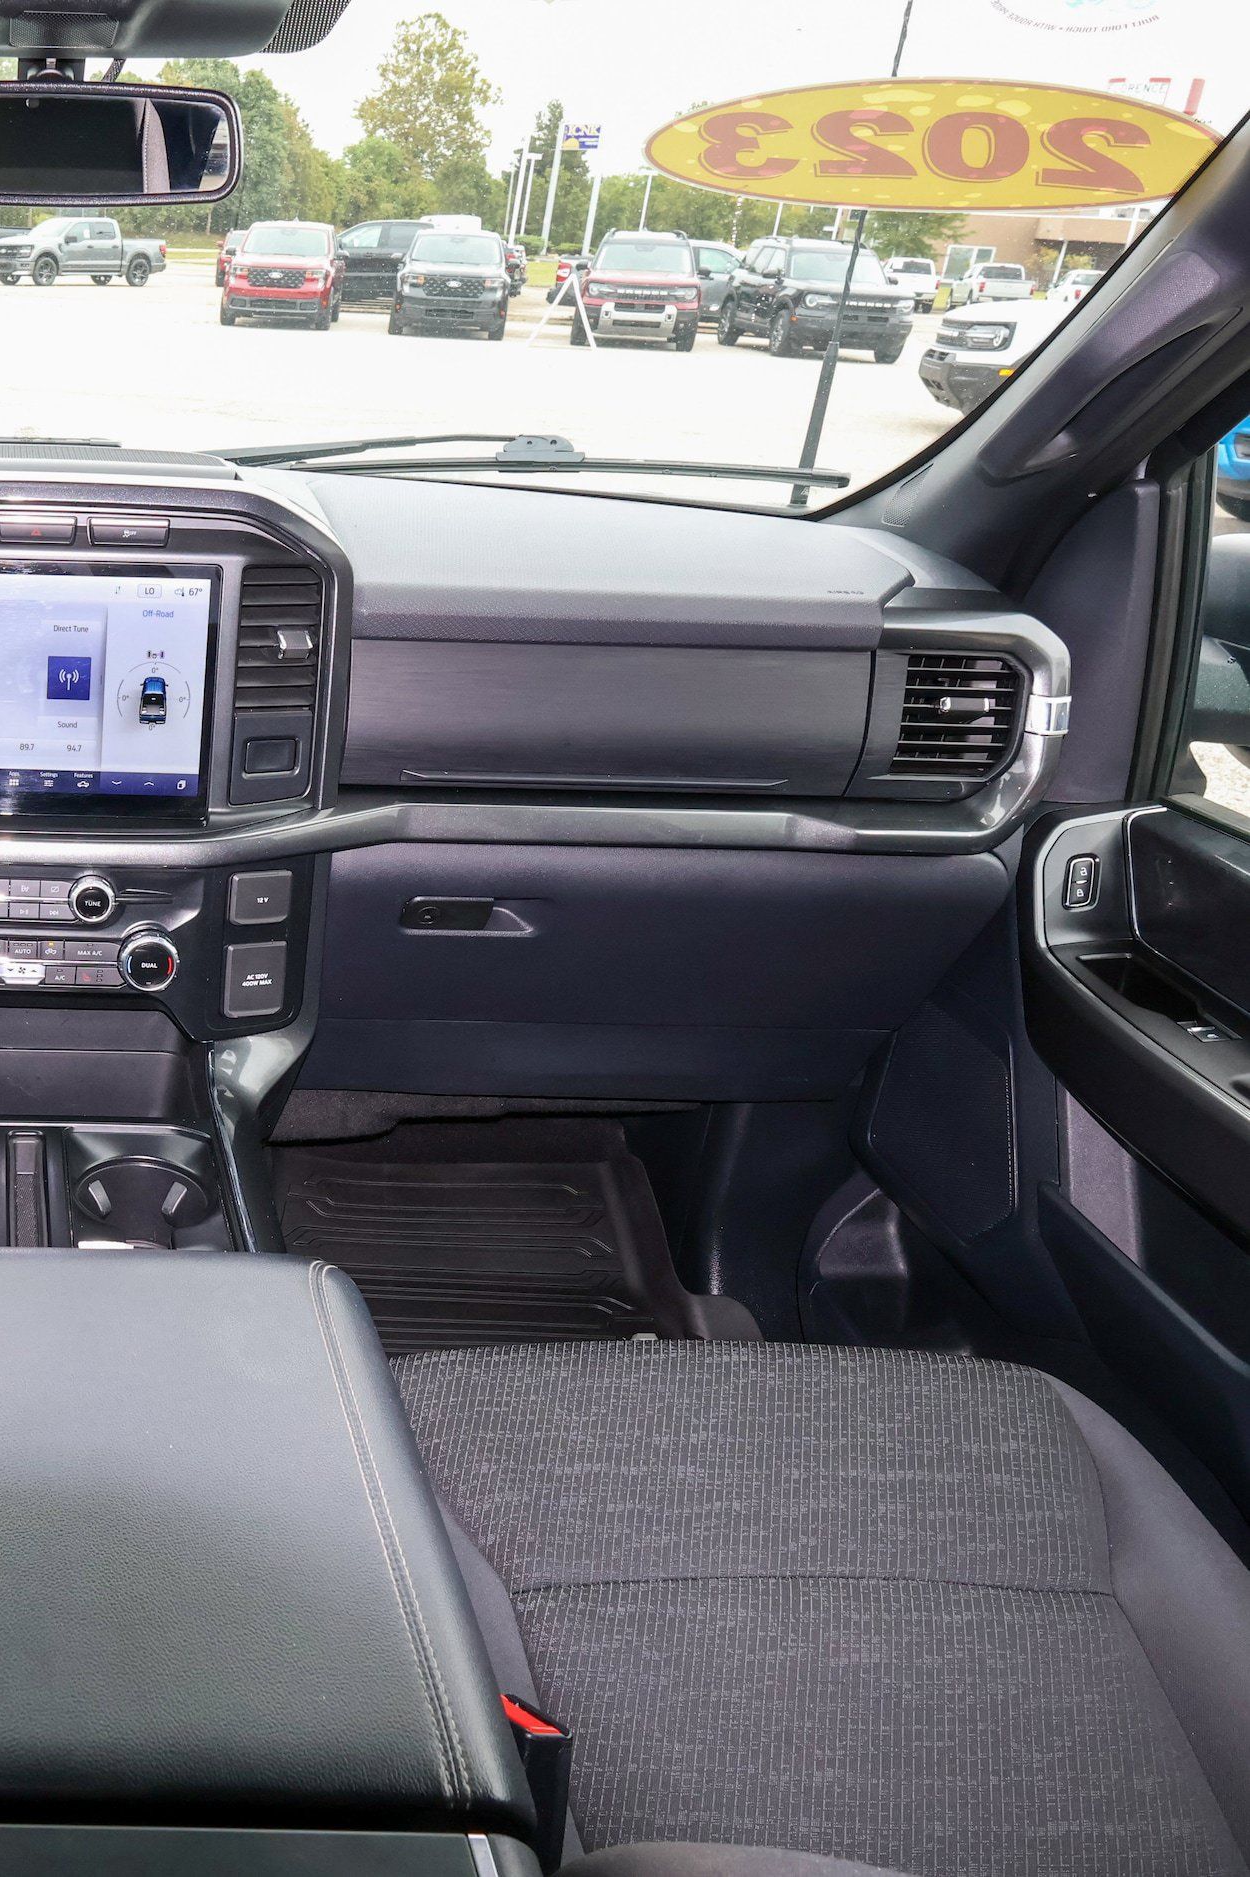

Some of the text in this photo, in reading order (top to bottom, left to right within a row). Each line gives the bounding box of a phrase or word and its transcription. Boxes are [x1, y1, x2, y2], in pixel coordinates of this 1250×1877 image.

[145, 587, 155, 595] LO
[142, 609, 174, 618] Off-Road
[53, 624, 89, 633] Direct Tune
[57, 721, 78, 729] Sound
[19, 743, 35, 751] 89.7
[66, 744, 82, 752] 94.7
[39, 771, 58, 779] Settings
